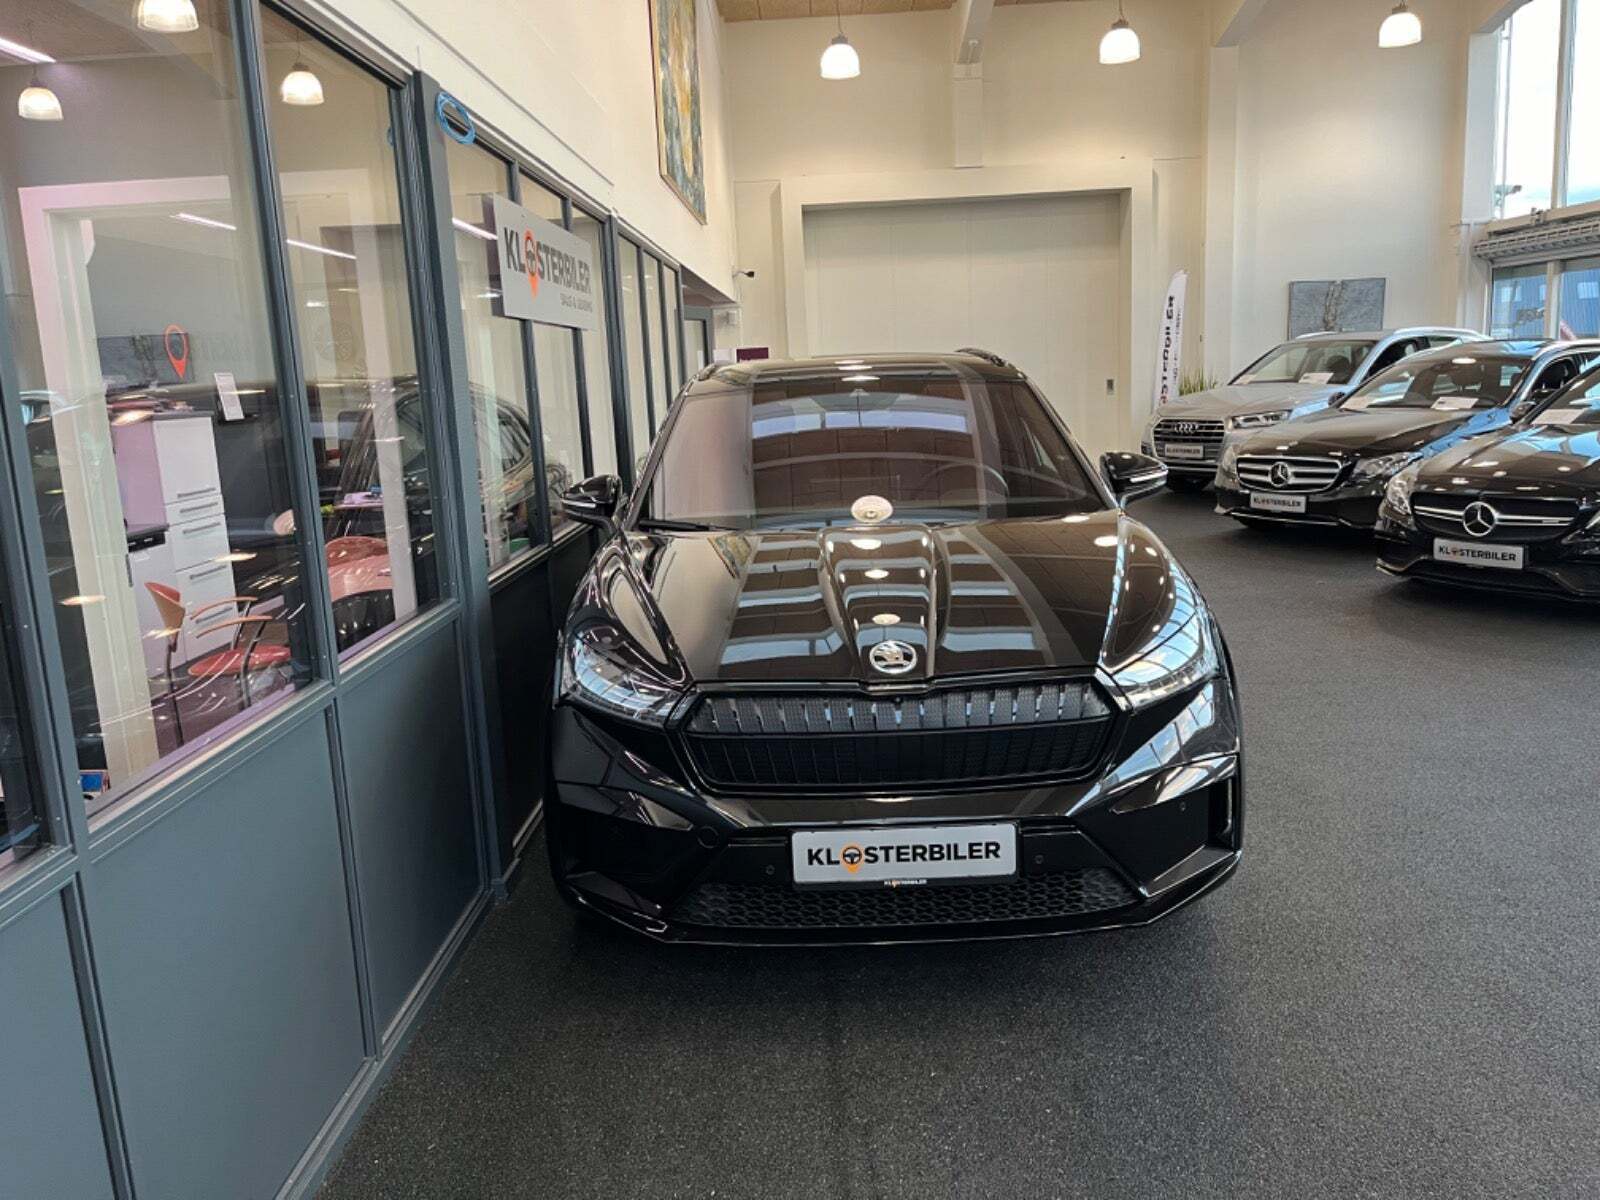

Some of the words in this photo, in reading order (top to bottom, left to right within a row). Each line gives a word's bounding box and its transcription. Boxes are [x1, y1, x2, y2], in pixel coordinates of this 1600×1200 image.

[504, 227, 591, 295] KLOSTERBILER
[1438, 546, 1517, 561] KLOSTERBILER
[807, 841, 1001, 869] KLOSTERBILER
